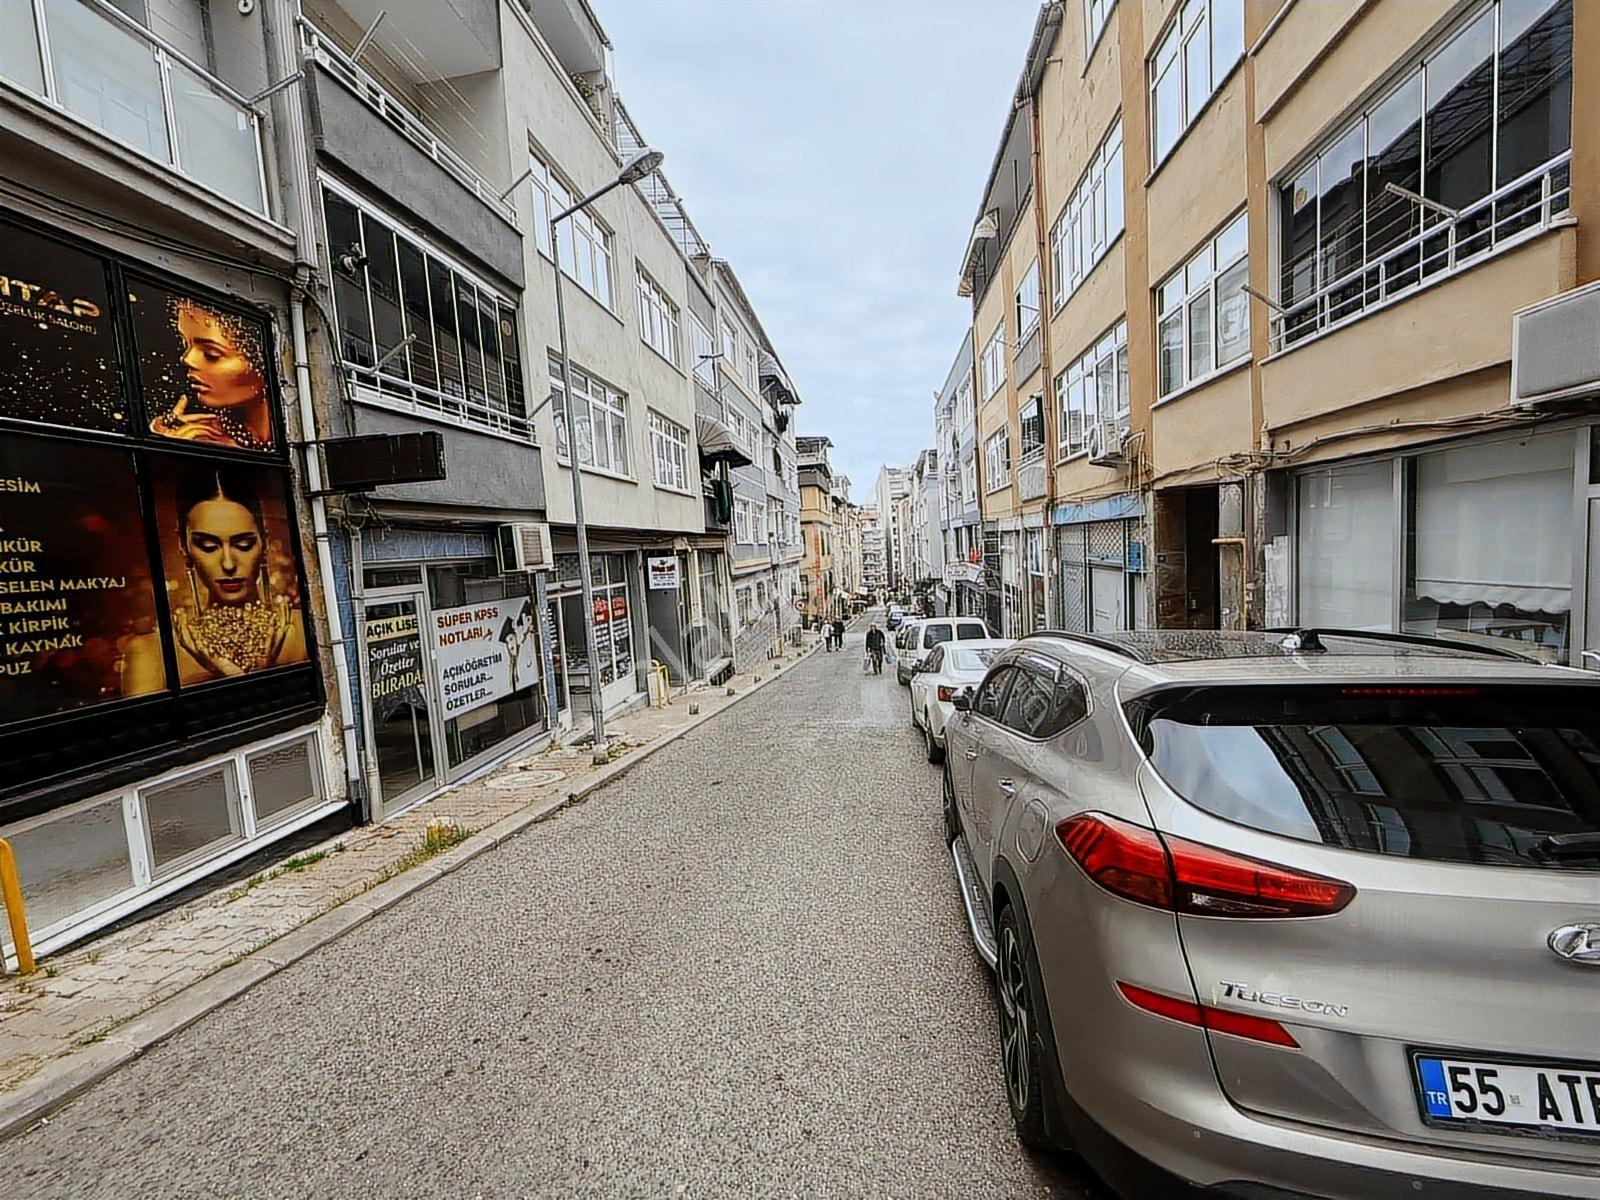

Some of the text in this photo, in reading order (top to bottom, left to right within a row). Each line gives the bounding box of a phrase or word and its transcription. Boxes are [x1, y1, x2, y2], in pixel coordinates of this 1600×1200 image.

[60, 576, 126, 591] MAKYAJ
[1, 598, 67, 614] BAKIMI
[9, 615, 70, 634] KİRPİK
[437, 607, 499, 629] SÜPER KPSS
[366, 622, 394, 638] AÇIK
[439, 626, 483, 647] NOTLARI
[6, 634, 84, 655] KAYNAK
[1219, 980, 1349, 1017] TUCSON
[1427, 1091, 1449, 1106] TR
[1448, 1066, 1506, 1116] 55
